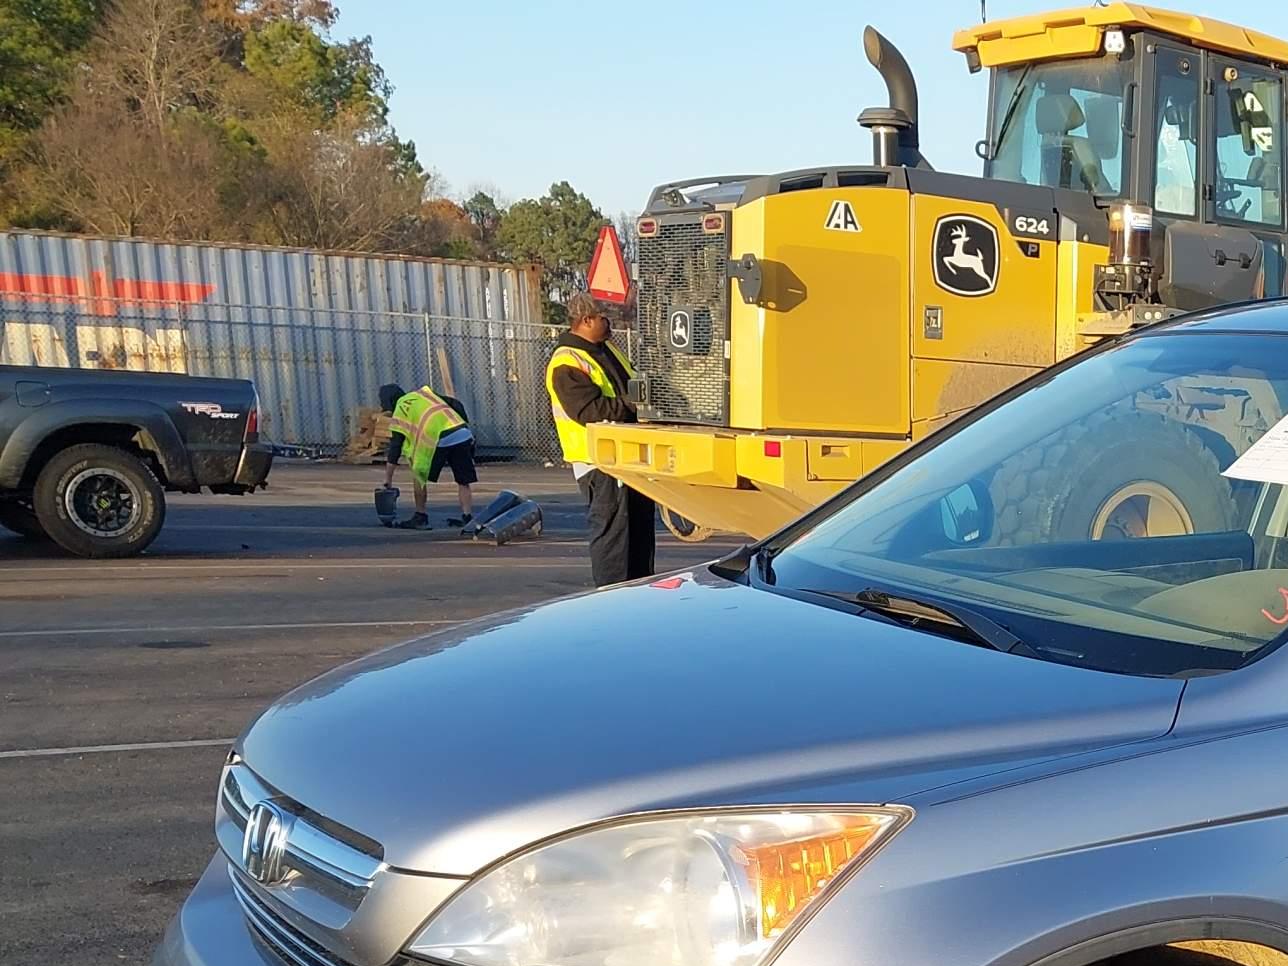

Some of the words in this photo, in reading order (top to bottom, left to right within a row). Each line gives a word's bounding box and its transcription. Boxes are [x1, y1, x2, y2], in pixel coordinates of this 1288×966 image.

[1015, 216, 1050, 235] 624
[1027, 243, 1038, 256] P
[180, 402, 222, 416] TRD
